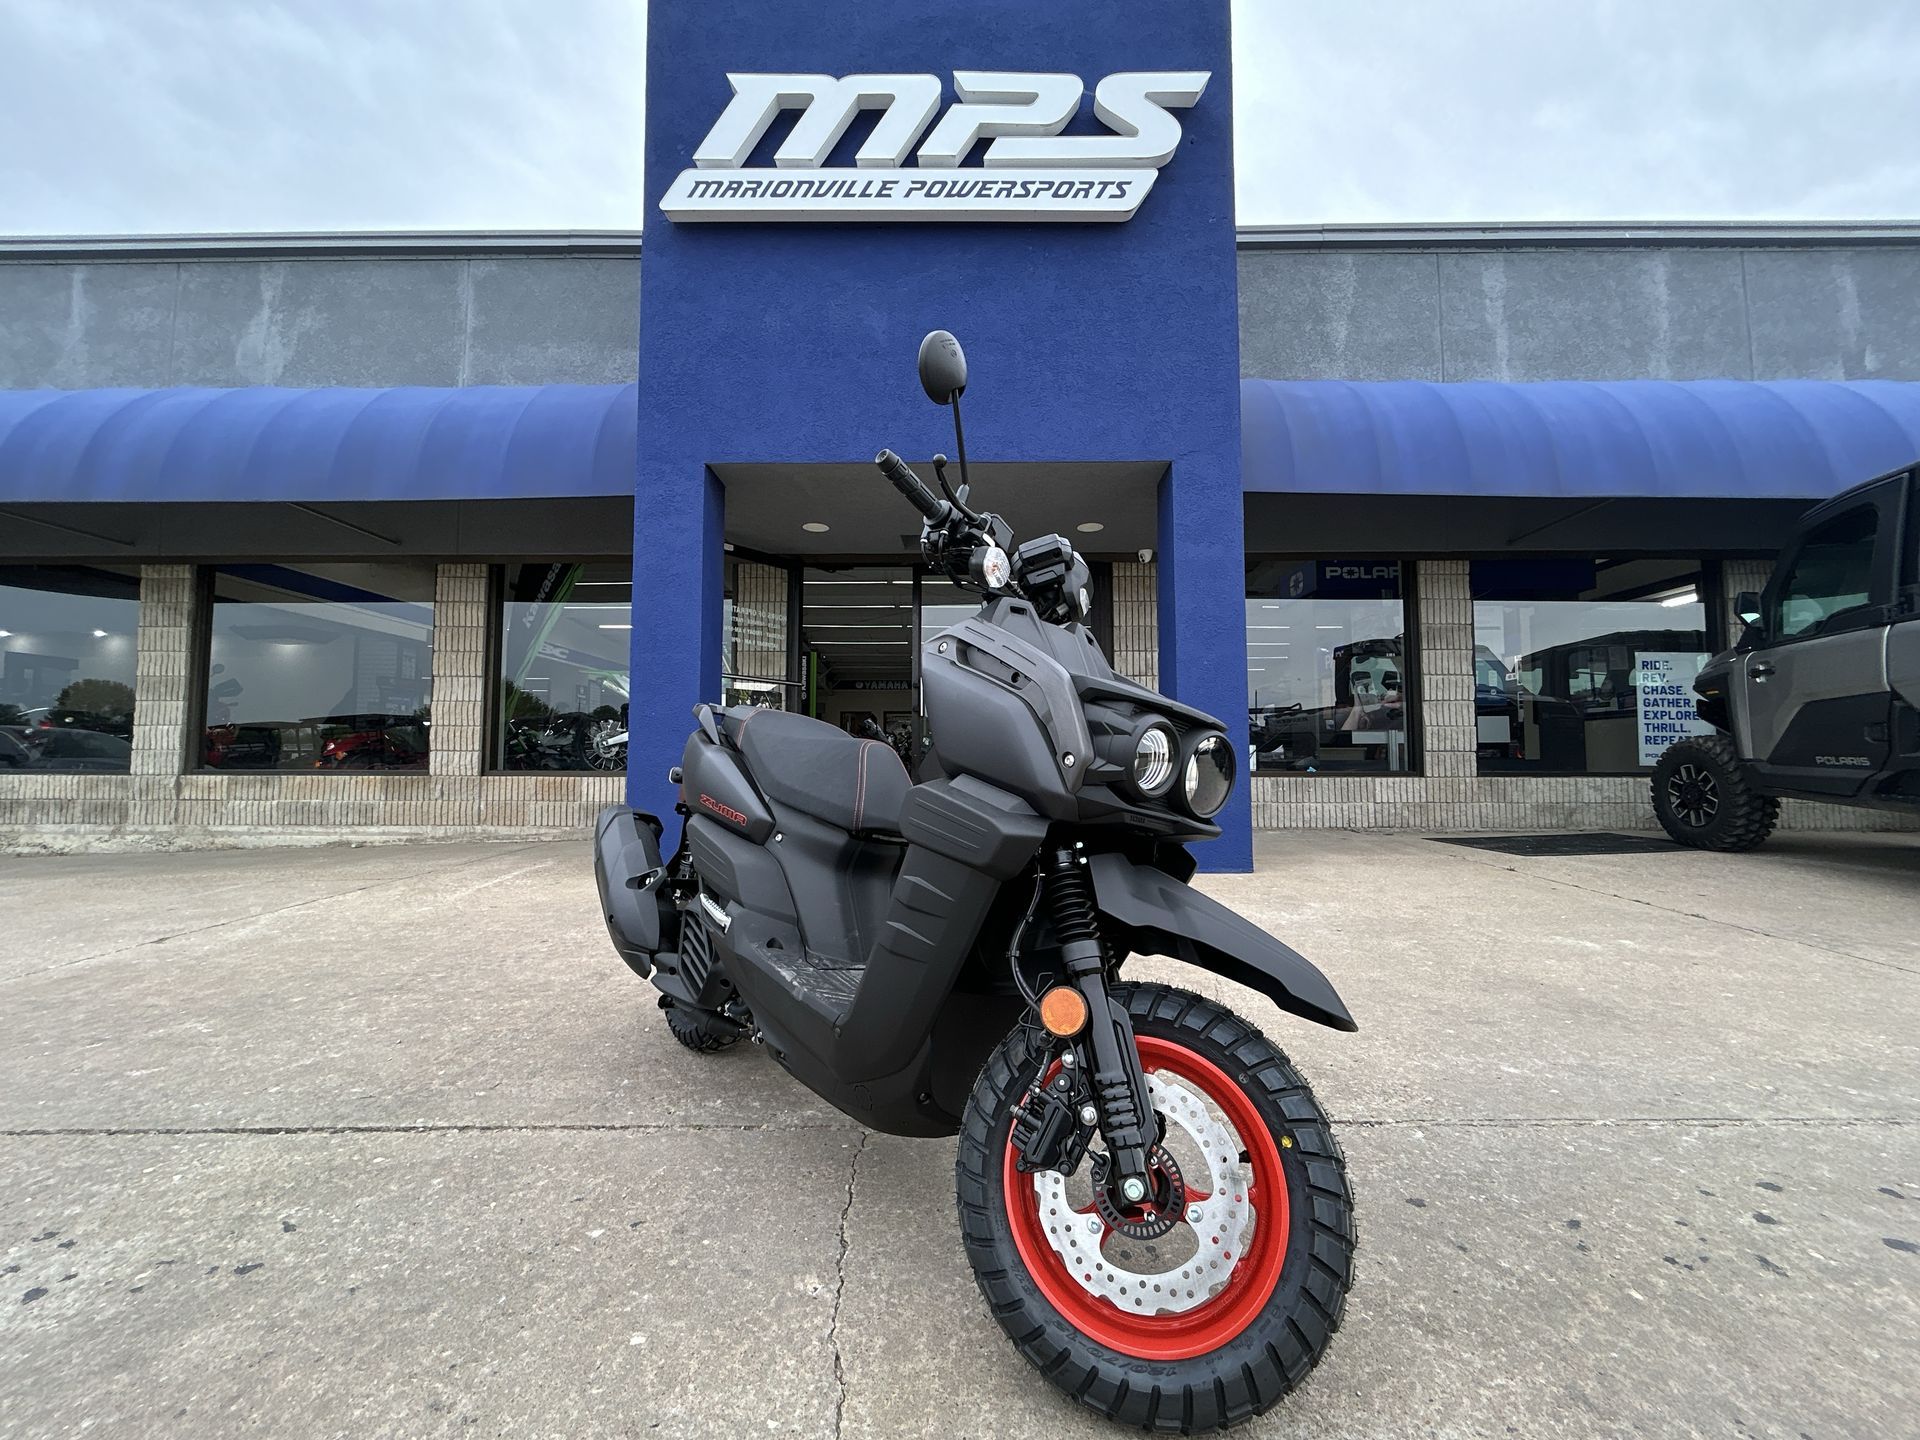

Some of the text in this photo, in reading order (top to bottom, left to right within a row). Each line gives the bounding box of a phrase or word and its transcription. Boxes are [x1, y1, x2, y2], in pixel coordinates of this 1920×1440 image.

[692, 70, 1212, 169] MPS
[686, 179, 1133, 200] MARIONVILLE POWERSPORTS
[1325, 566, 1400, 579] POLAR
[522, 562, 562, 629] Kawasa
[1641, 660, 1673, 671] RIDE.
[1642, 673, 1669, 683] REV.
[864, 682, 909, 690] YAMAHA
[1642, 685, 1687, 696] CHASE.
[1643, 698, 1695, 708] GATHER.
[1644, 723, 1692, 733] THRILL.
[1815, 756, 1871, 766] POLARIS
[699, 793, 747, 826] ZUMA
